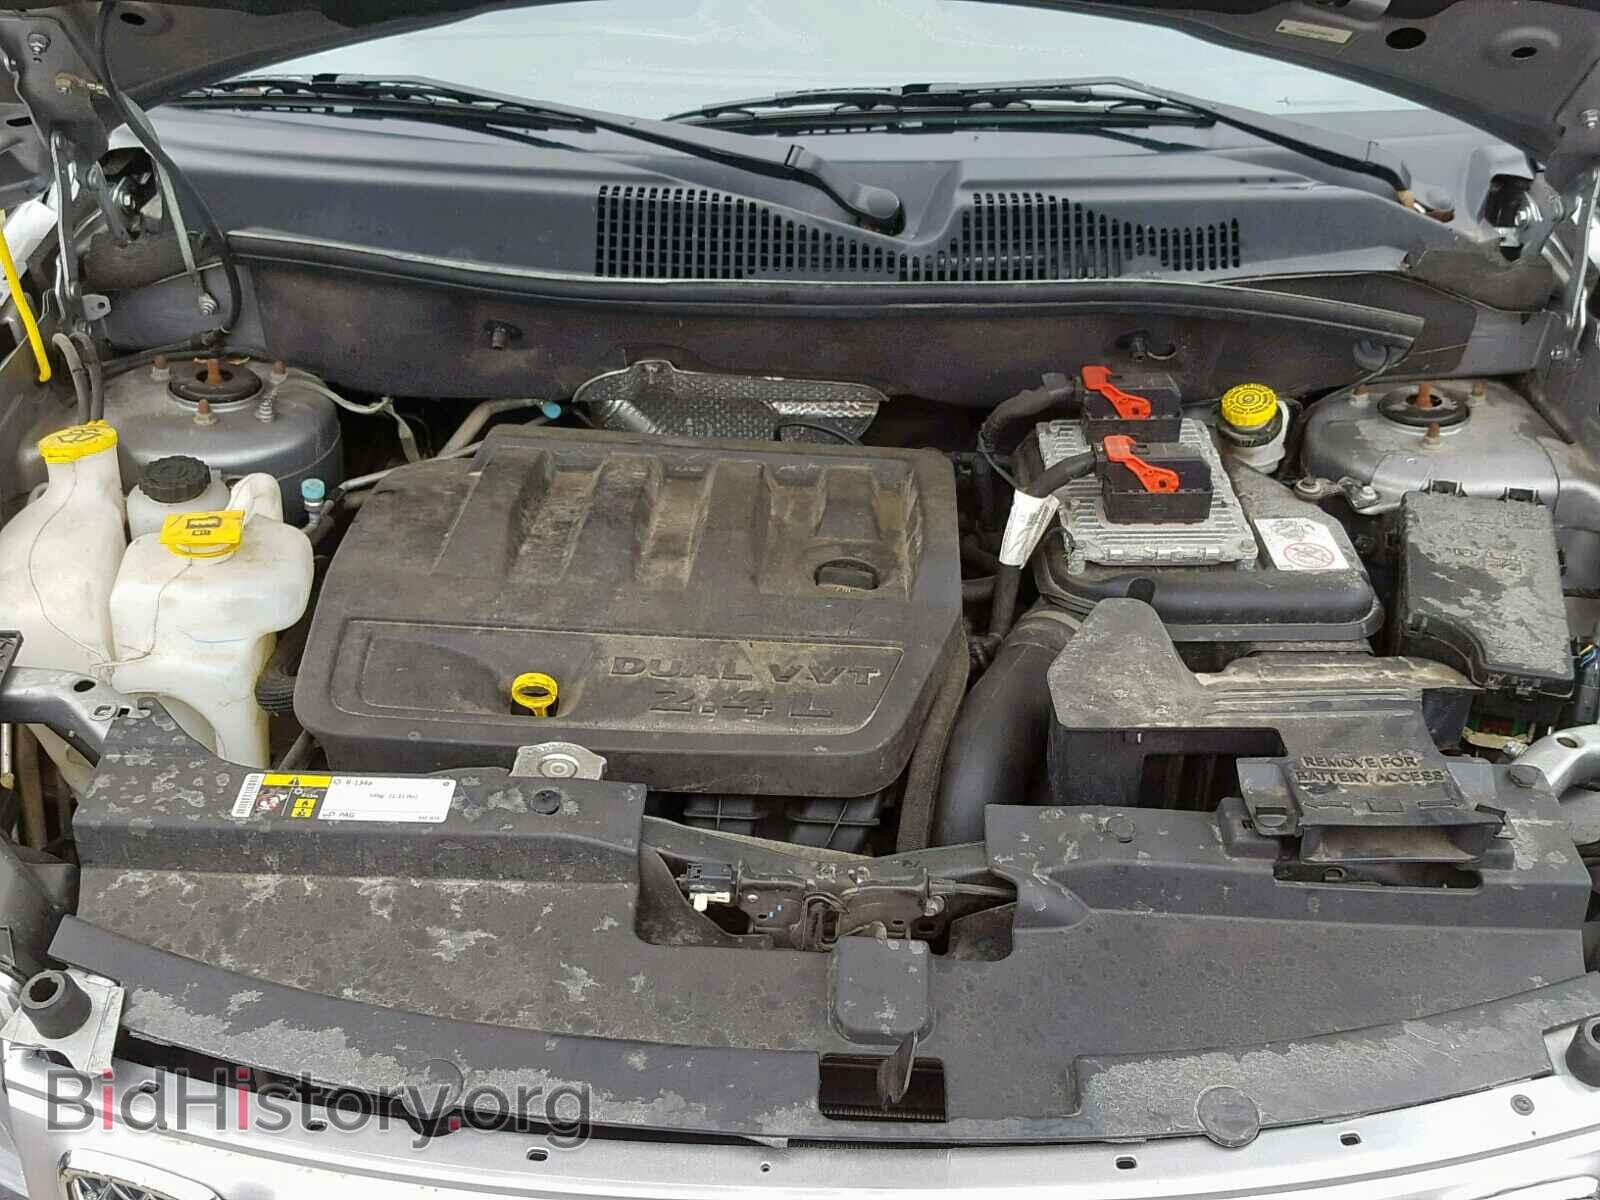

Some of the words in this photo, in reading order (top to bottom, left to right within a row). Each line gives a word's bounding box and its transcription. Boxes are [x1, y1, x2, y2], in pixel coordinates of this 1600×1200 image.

[768, 663, 881, 686] VVT
[1302, 755, 1378, 769] REMOVE
[1381, 755, 1419, 769] FOR
[1296, 769, 1370, 784] BATTERY
[1376, 769, 1446, 784] ACCESS
